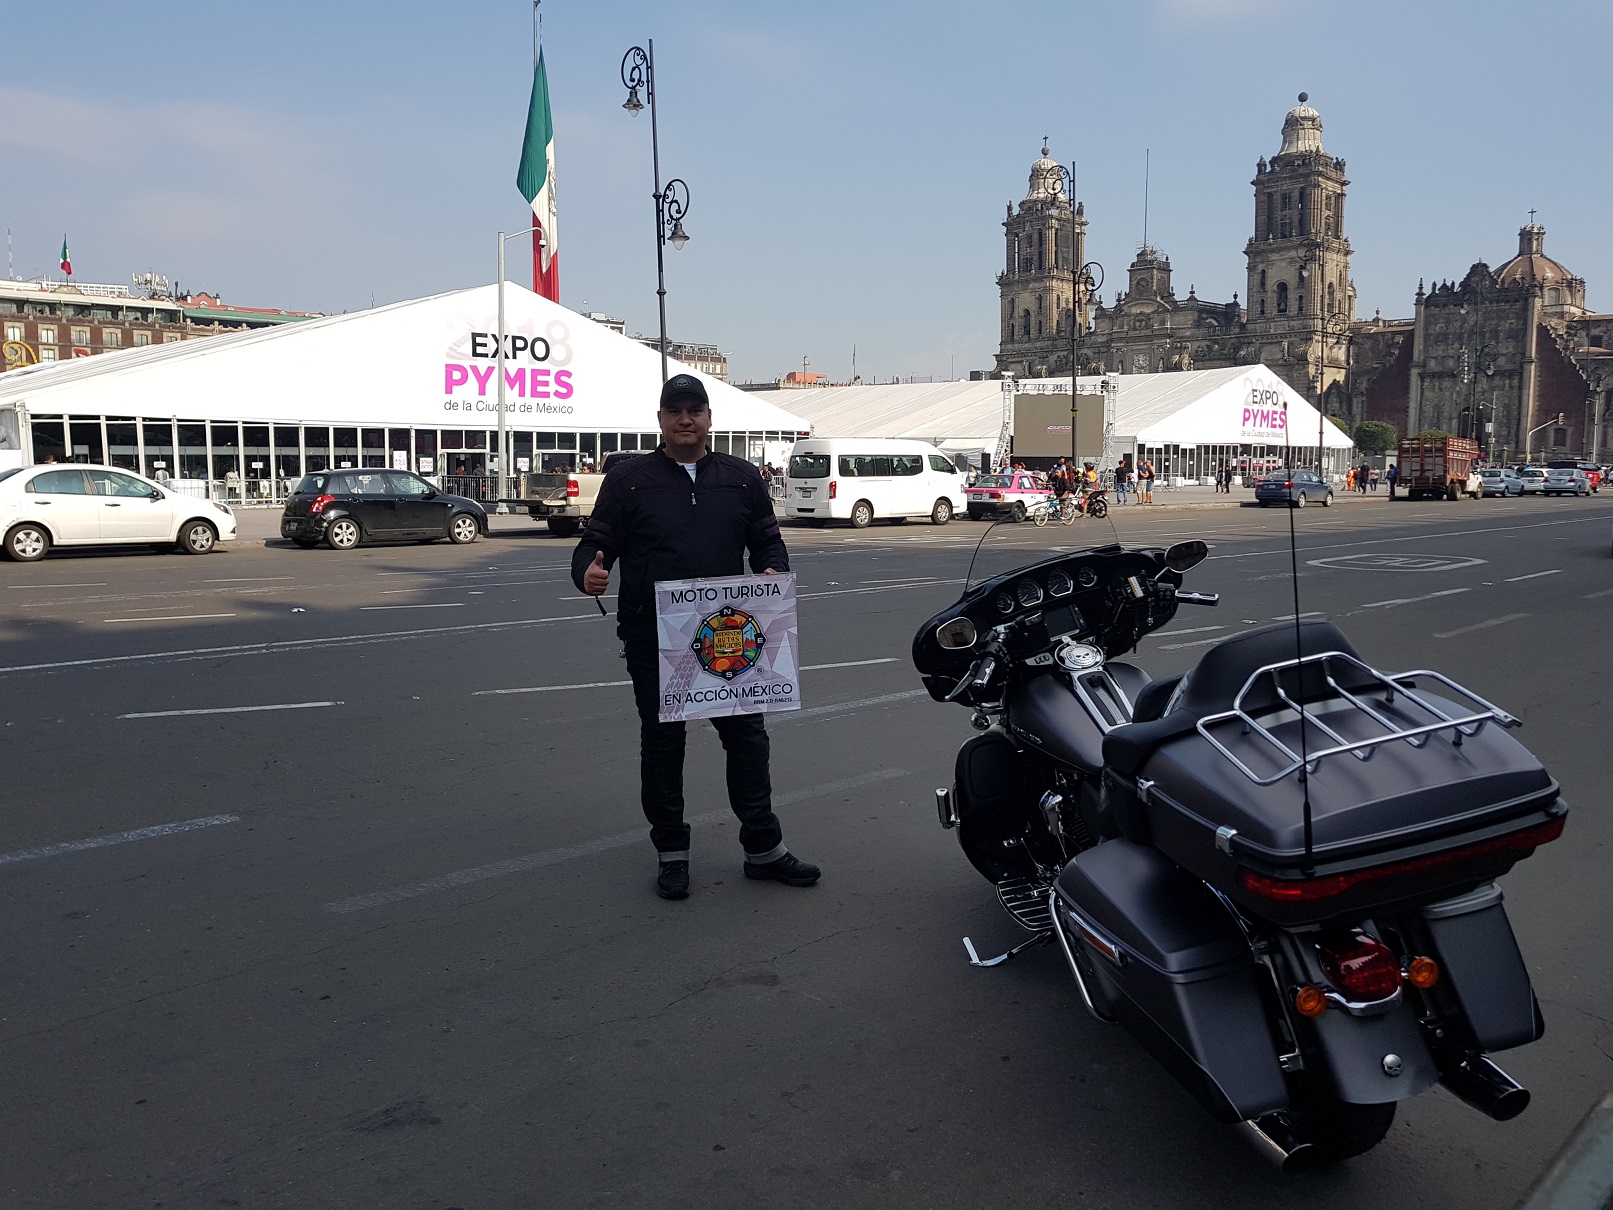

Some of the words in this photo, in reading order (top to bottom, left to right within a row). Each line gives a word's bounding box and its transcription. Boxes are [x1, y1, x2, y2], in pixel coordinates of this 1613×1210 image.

[471, 332, 551, 362] EXPO
[445, 364, 574, 400] PYMES
[444, 400, 459, 411] de
[462, 400, 472, 411] la
[519, 402, 533, 413] de
[536, 402, 574, 414] México
[1252, 389, 1279, 406] EXPO
[1242, 408, 1286, 429] PYMES
[671, 588, 718, 604] MOTO
[722, 583, 781, 600] TURISTA
[664, 693, 682, 706] EN
[684, 685, 739, 704] ACCIÓN
[741, 683, 793, 699] MÉXICO
